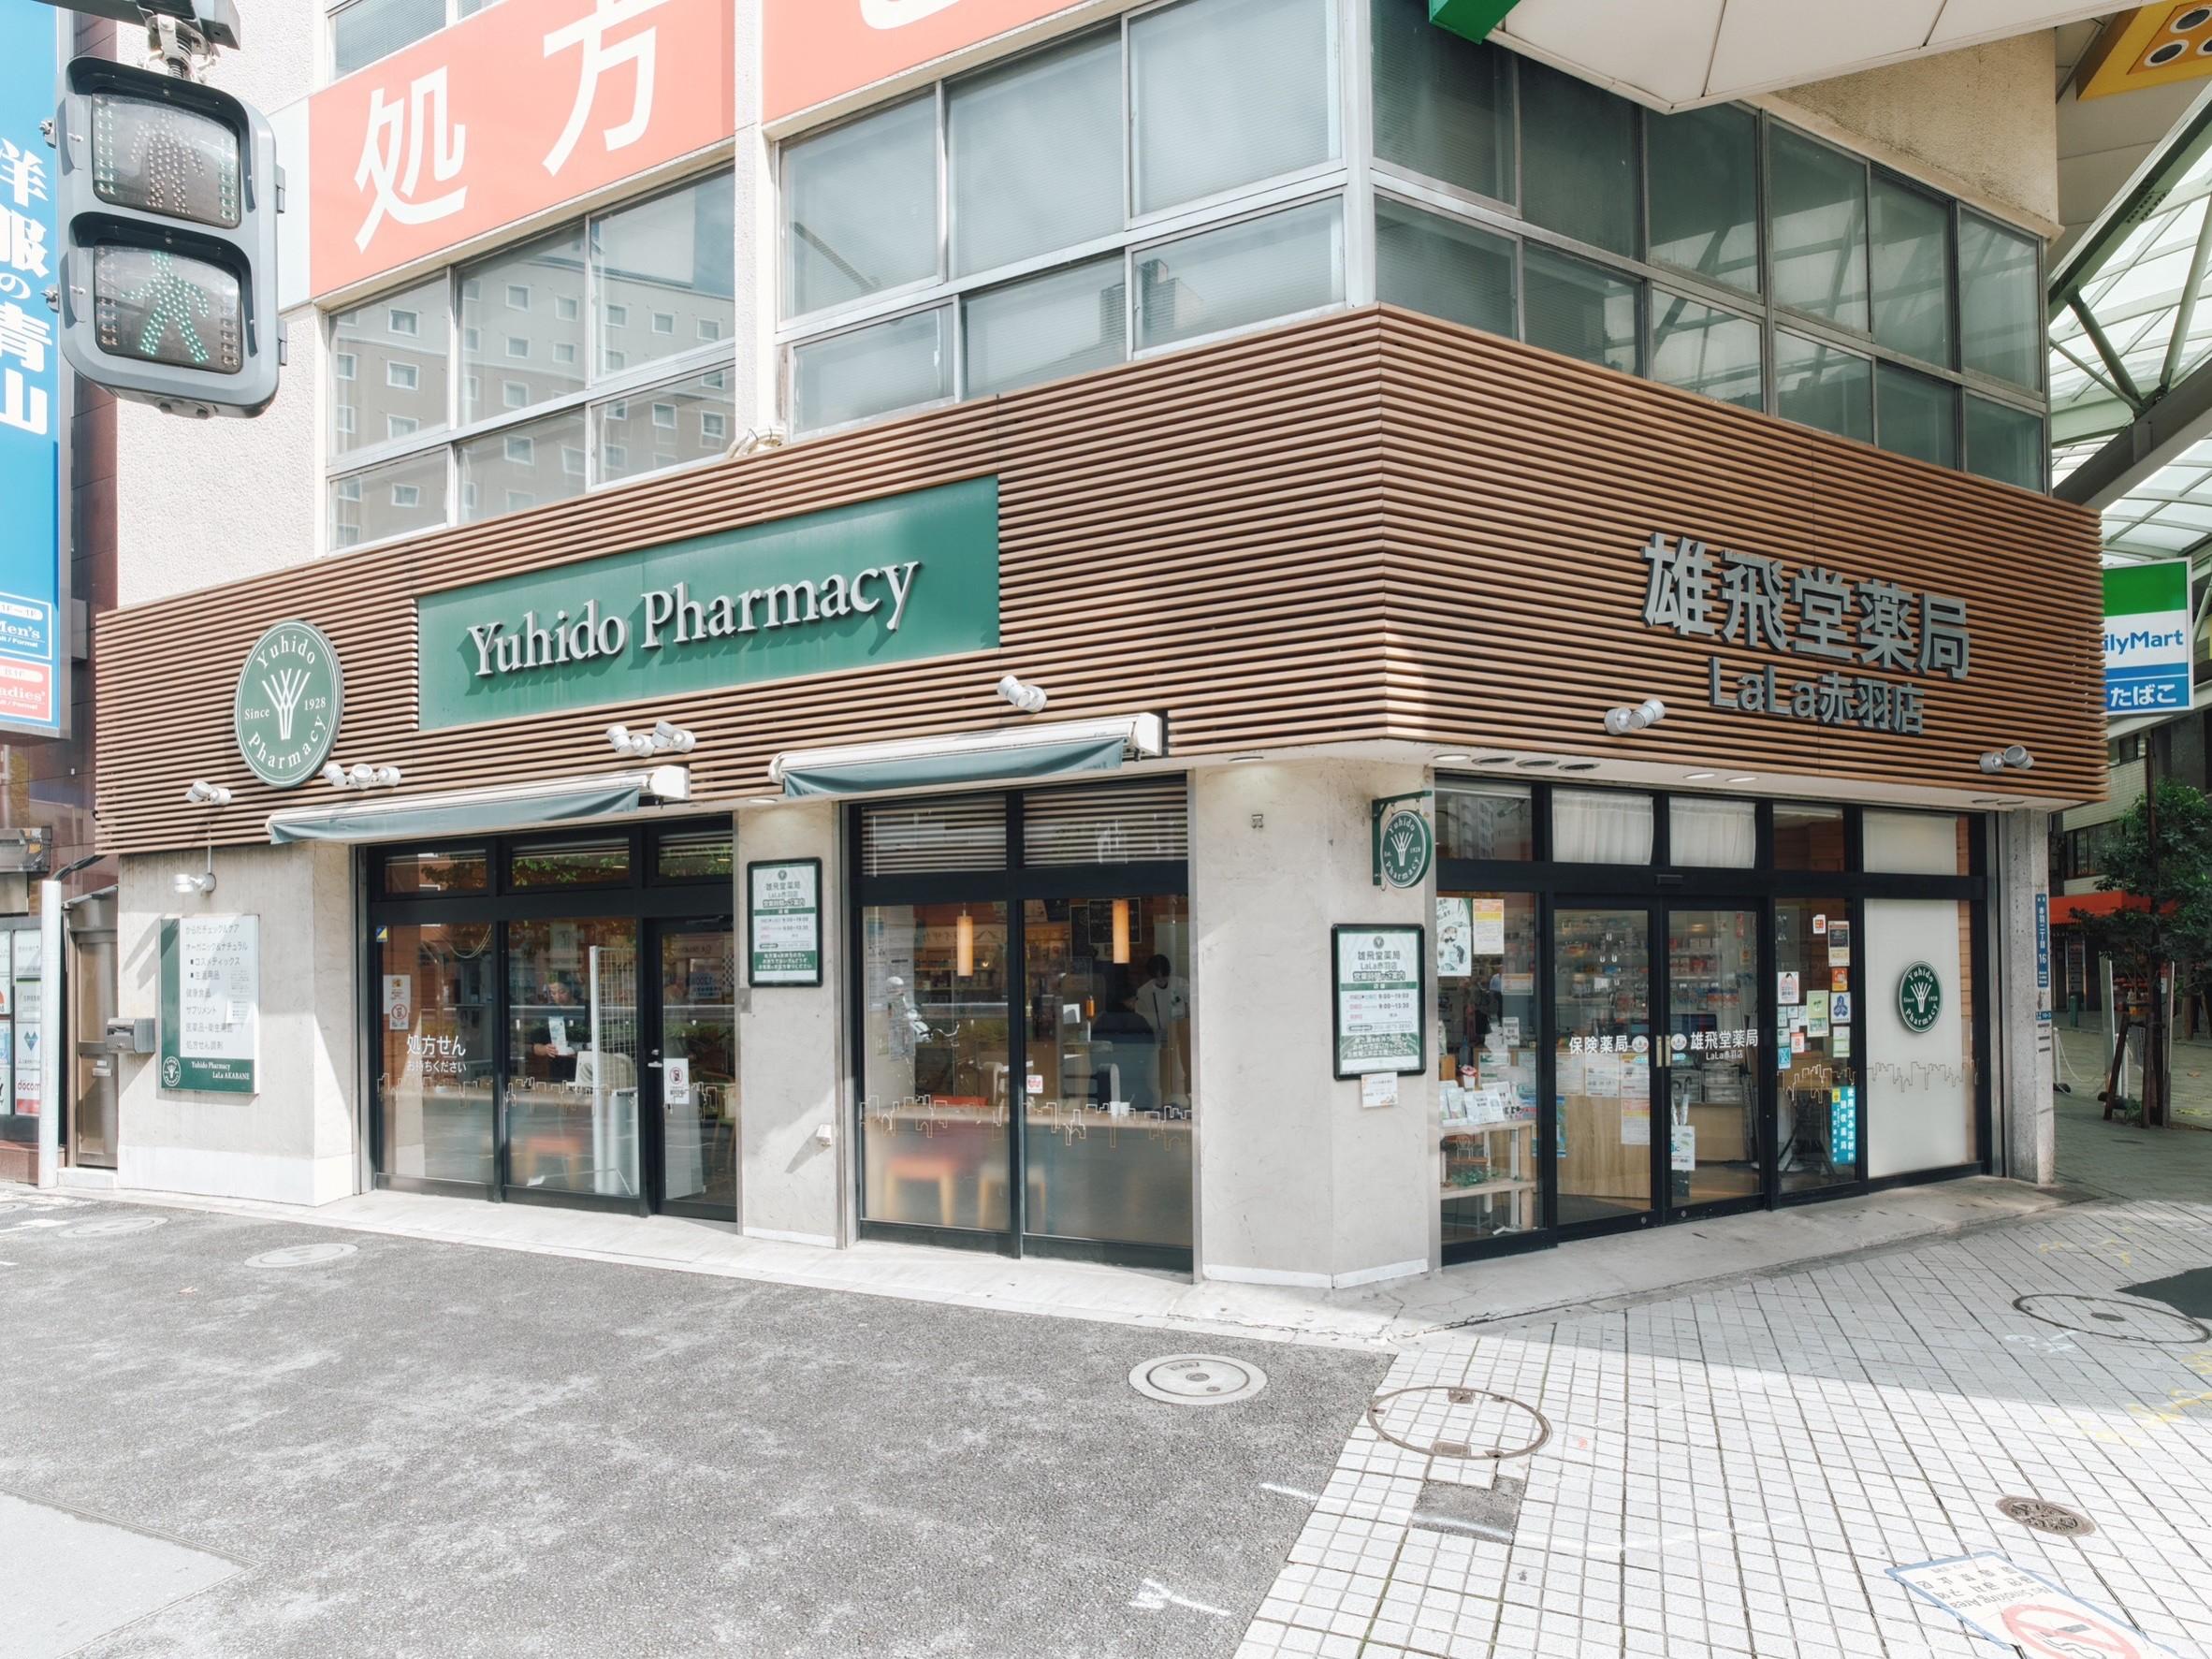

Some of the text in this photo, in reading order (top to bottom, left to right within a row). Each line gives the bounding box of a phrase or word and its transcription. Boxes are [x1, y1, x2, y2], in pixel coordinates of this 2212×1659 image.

[1640, 531, 1970, 679] 雄飛堂薬局
[467, 561, 924, 677] Yuhido Pharmacy
[256, 635, 315, 669] Yuhido
[1710, 656, 1925, 735] LaLa赤羽店
[2110, 684, 2176, 707] たばこ
[244, 697, 327, 720] Since 1928
[248, 715, 327, 770] Pharmacy
[1389, 817, 1416, 834] Yuhido
[1386, 856, 1421, 880] Pharmacy
[2038, 953, 2046, 965] 16
[1908, 967, 1934, 982] Yuhido
[1905, 1005, 1939, 1026] Pharmacy
[406, 1034, 467, 1057] 処方せん
[1568, 1035, 1628, 1055] 保険薬局
[1690, 1028, 1759, 1050] 雄飛堂薬局
[191, 1060, 231, 1071] Yuhido Pharmacy
[224, 1071, 251, 1081] AKABANE
[406, 1059, 467, 1073] お持ちください
[1949, 1598, 1983, 1609] Area
